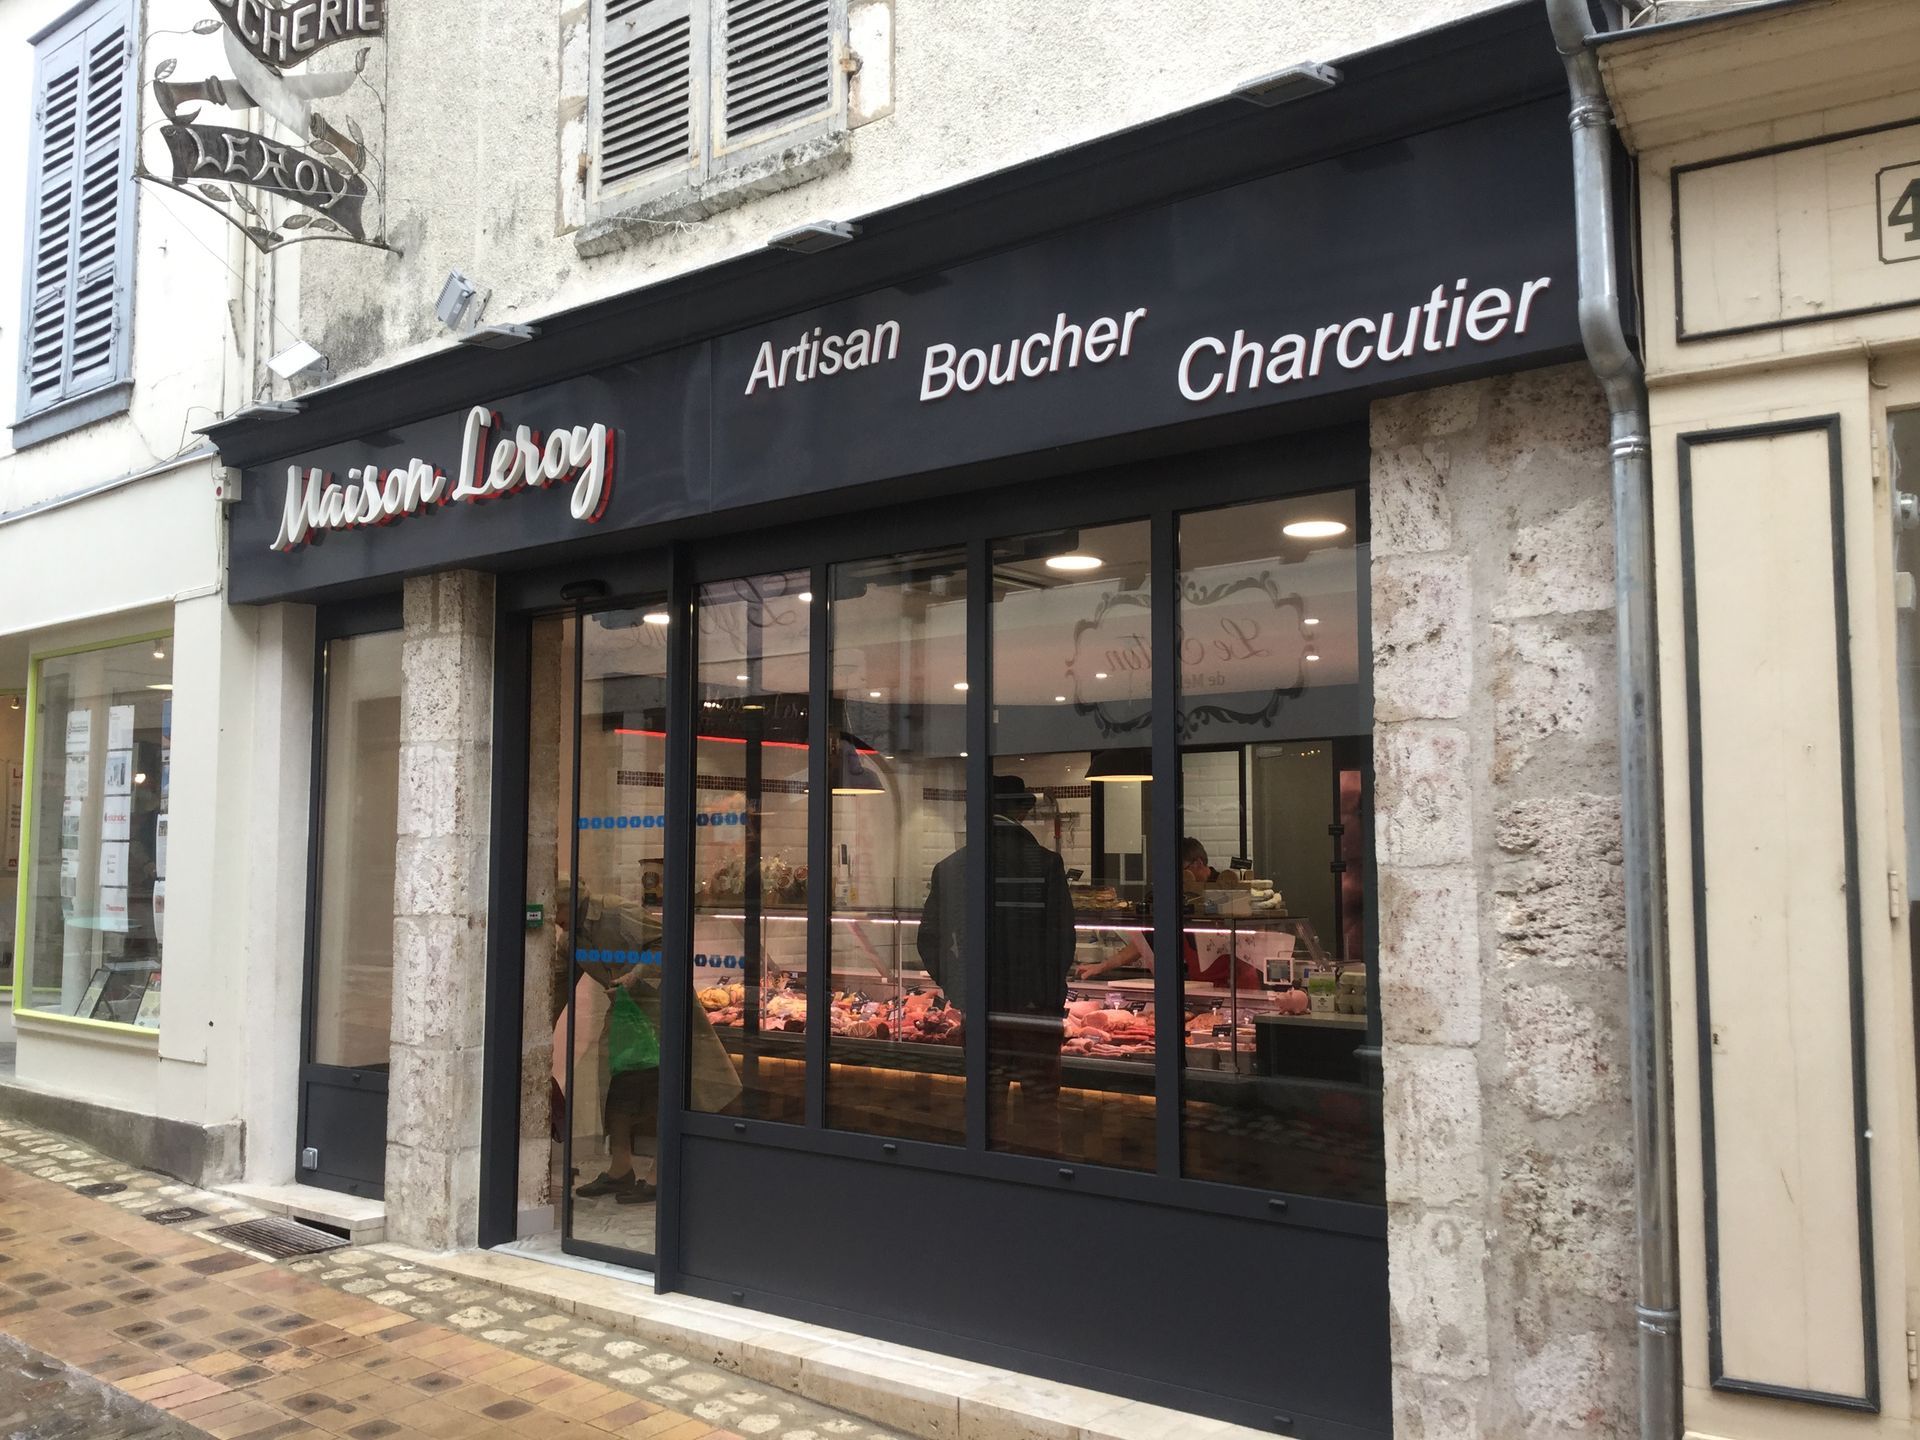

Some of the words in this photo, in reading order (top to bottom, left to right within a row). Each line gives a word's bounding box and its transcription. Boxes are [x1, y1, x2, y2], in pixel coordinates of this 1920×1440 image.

[222, 0, 380, 62] CHERIE
[186, 127, 349, 209] LEROY
[744, 319, 900, 395] Artisan
[920, 306, 1147, 401] Boucher
[1177, 277, 1551, 401] Charcutier
[269, 457, 448, 552] Maison
[451, 404, 608, 521] Leroy
